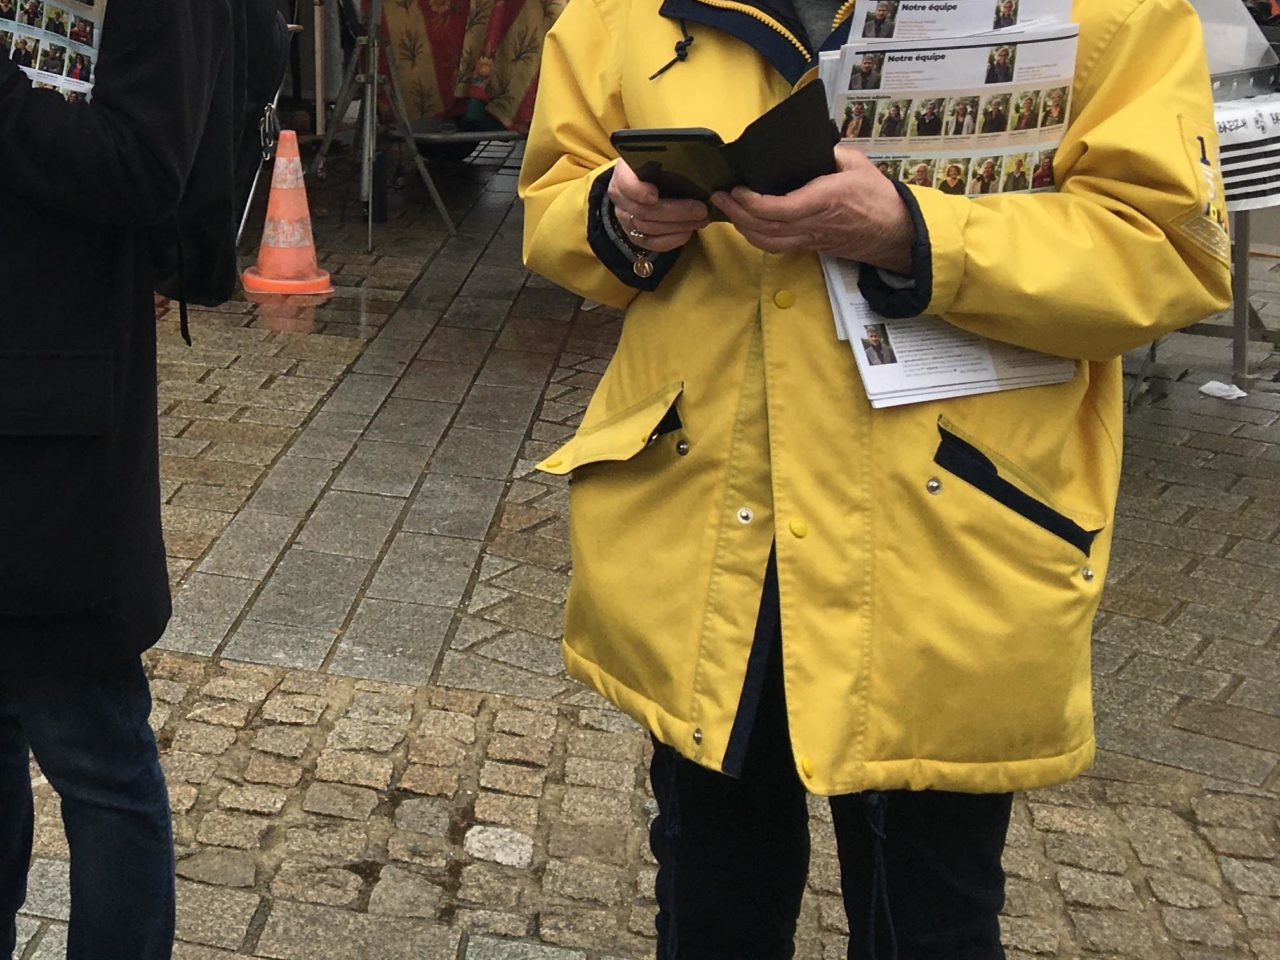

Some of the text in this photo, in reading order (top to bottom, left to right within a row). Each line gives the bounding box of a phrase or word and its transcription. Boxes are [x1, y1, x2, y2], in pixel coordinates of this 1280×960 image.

[901, 2, 958, 13] Notre équipe
[887, 52, 947, 63] Notre équipe
